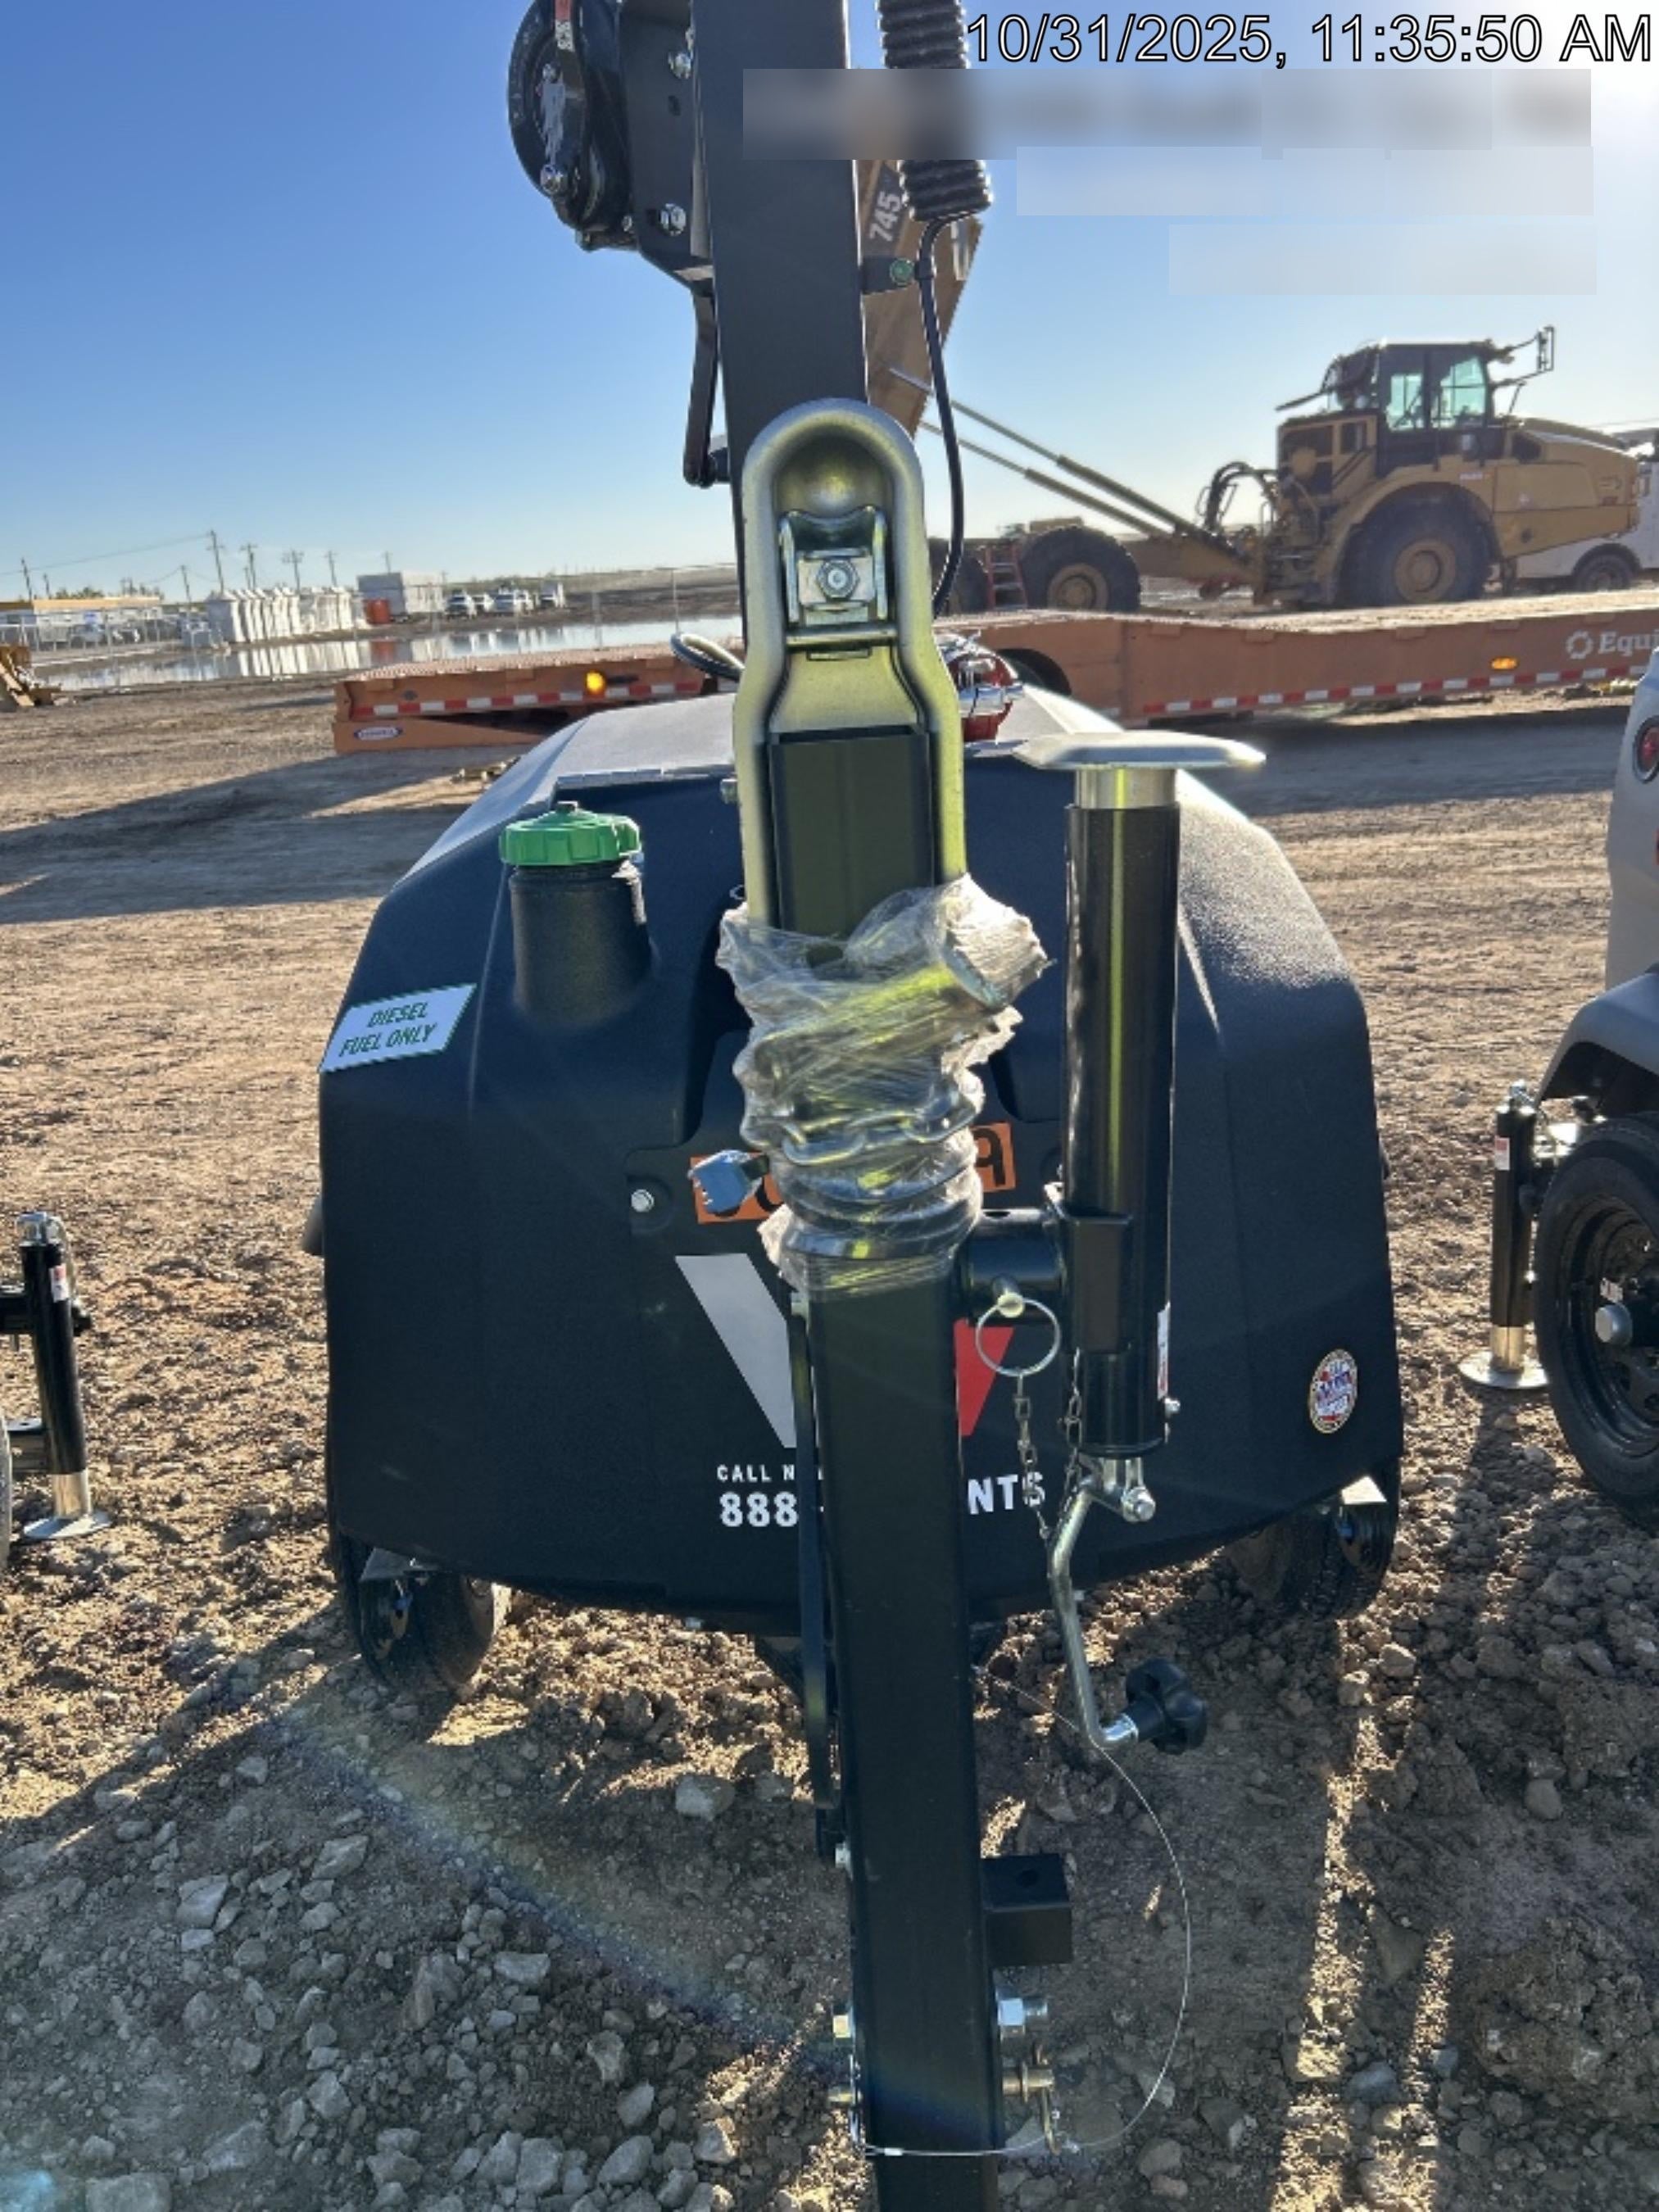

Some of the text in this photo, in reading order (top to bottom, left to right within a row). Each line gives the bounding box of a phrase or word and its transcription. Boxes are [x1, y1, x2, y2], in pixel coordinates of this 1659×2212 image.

[869, 190, 902, 242] 745
[366, 1001, 428, 1027] DIESEL
[338, 1022, 438, 1058] FUEL ONLY
[716, 1463, 772, 1483] CALL
